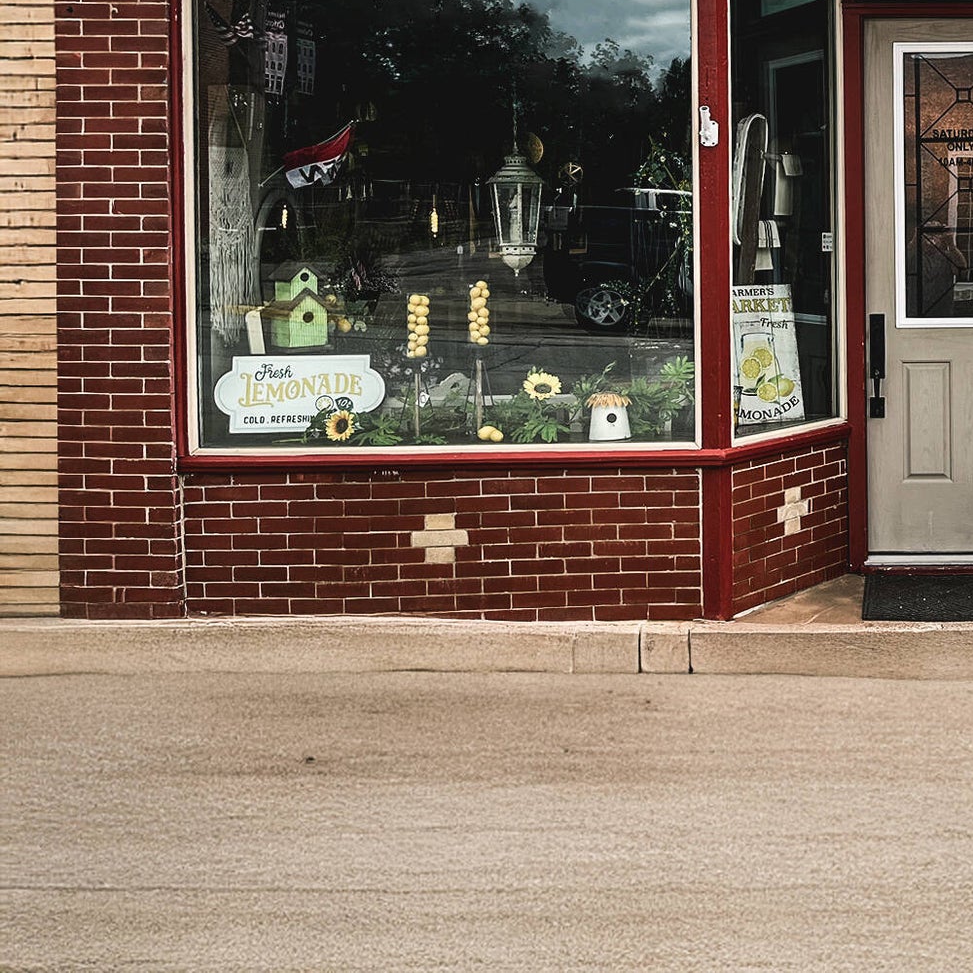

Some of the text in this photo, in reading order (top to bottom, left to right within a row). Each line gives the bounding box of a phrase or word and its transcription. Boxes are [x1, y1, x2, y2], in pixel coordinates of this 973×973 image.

[760, 317, 788, 329] Fresh
[254, 363, 294, 382] Fresh
[238, 372, 363, 408] LEMONADE
